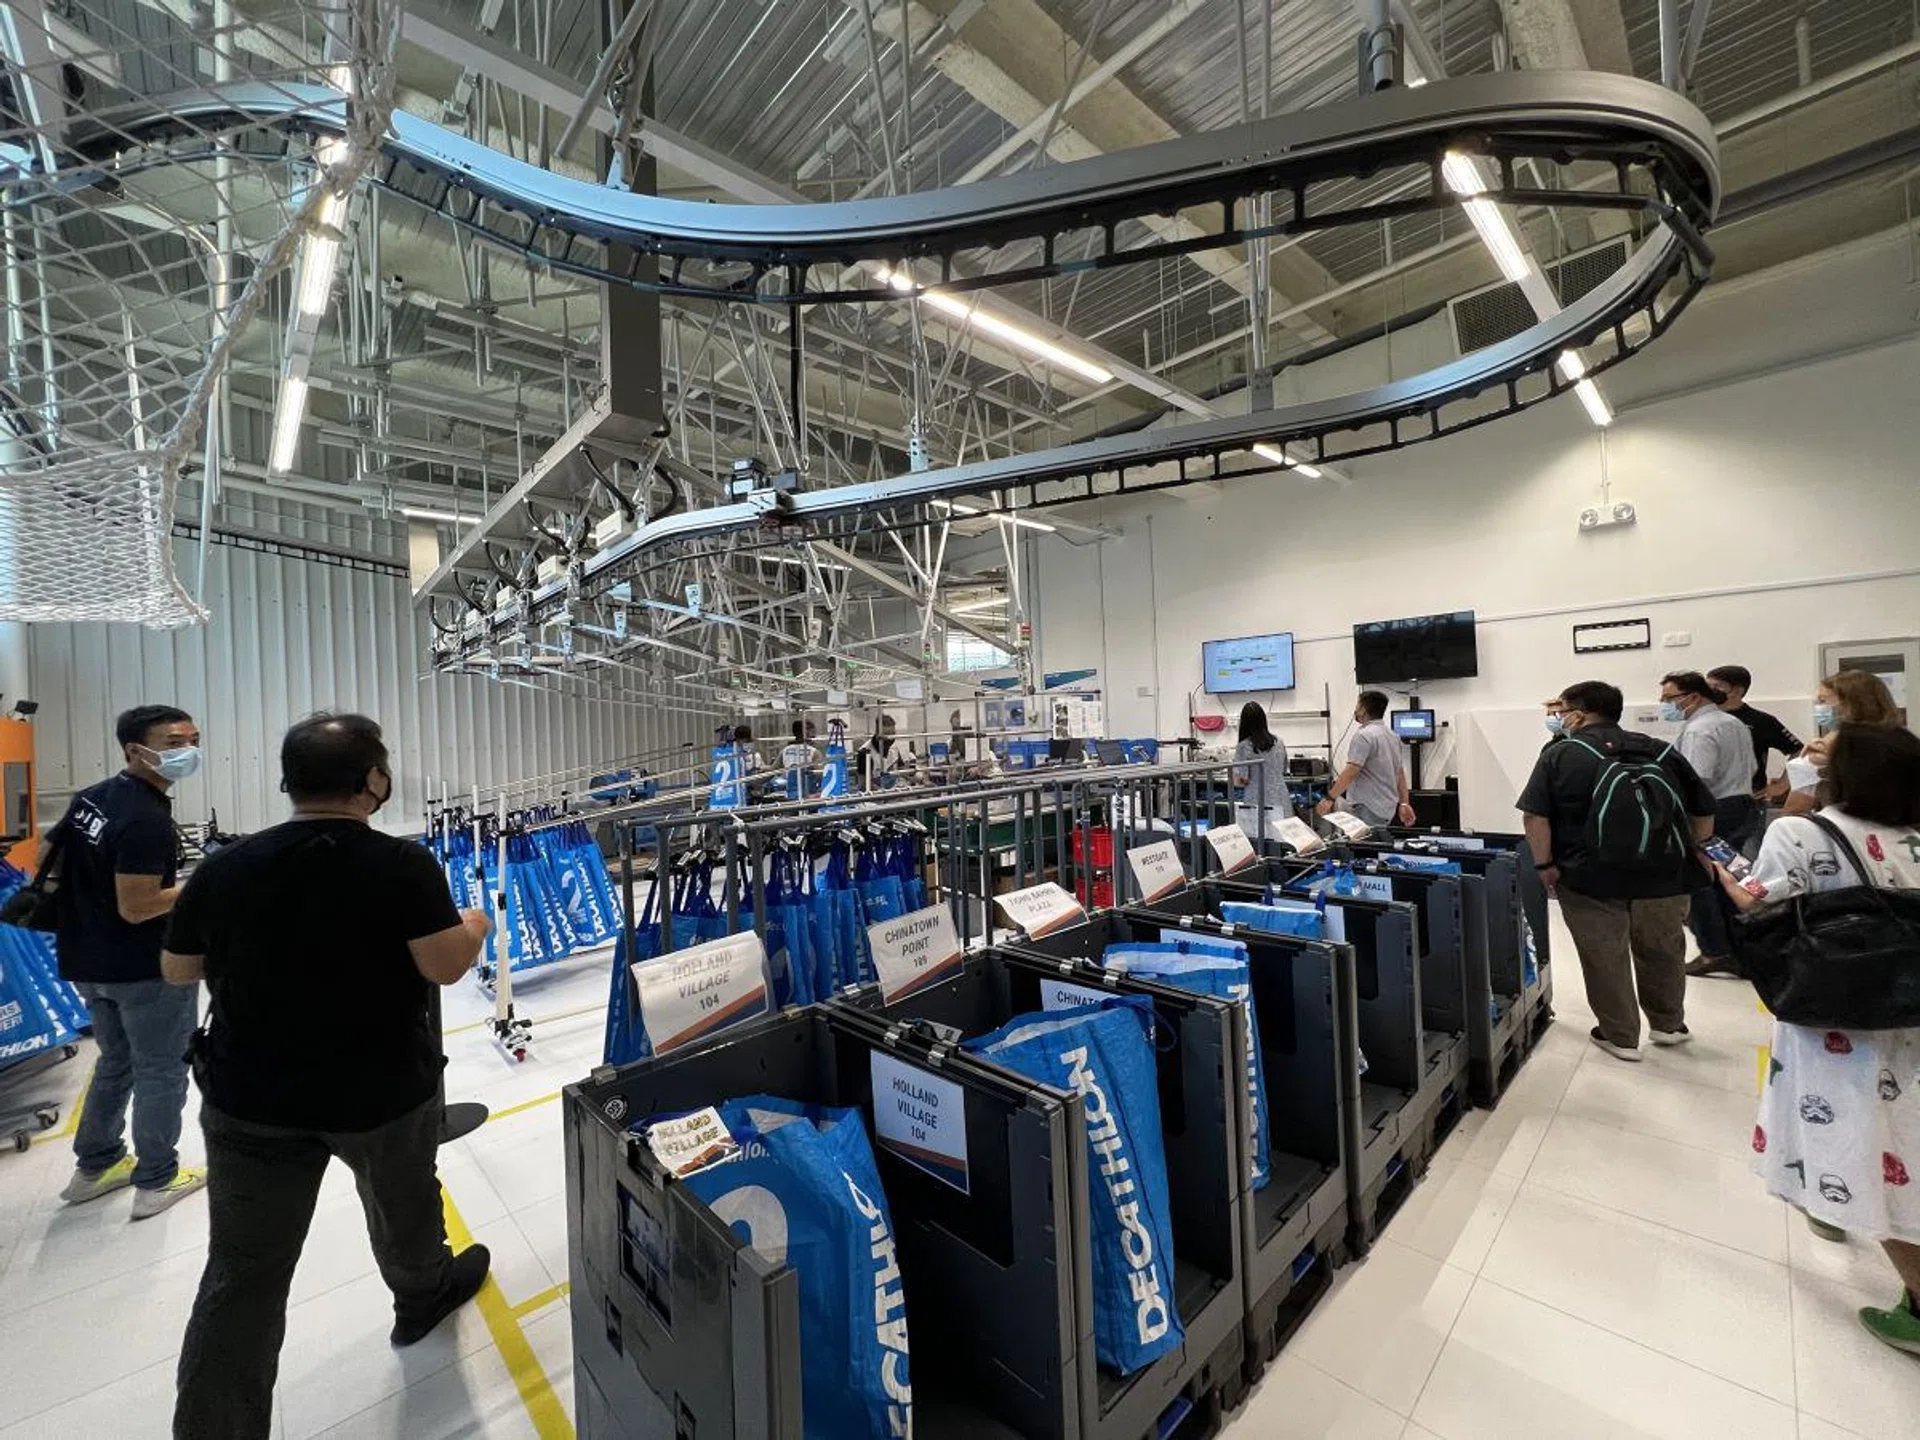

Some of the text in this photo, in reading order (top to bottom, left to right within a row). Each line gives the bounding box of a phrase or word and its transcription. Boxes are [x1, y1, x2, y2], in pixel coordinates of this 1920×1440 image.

[885, 915, 940, 944] CHINATOWN
[901, 936, 930, 957] POINT
[672, 951, 733, 981] HOLLAND
[678, 970, 731, 999] VILLAGE
[699, 994, 720, 1011] 104
[892, 1076, 940, 1108] HOLLAND
[897, 1099, 938, 1130] VILLAGE
[910, 1125, 926, 1142] 104
[1060, 1046, 1168, 1345] DECATHLON
